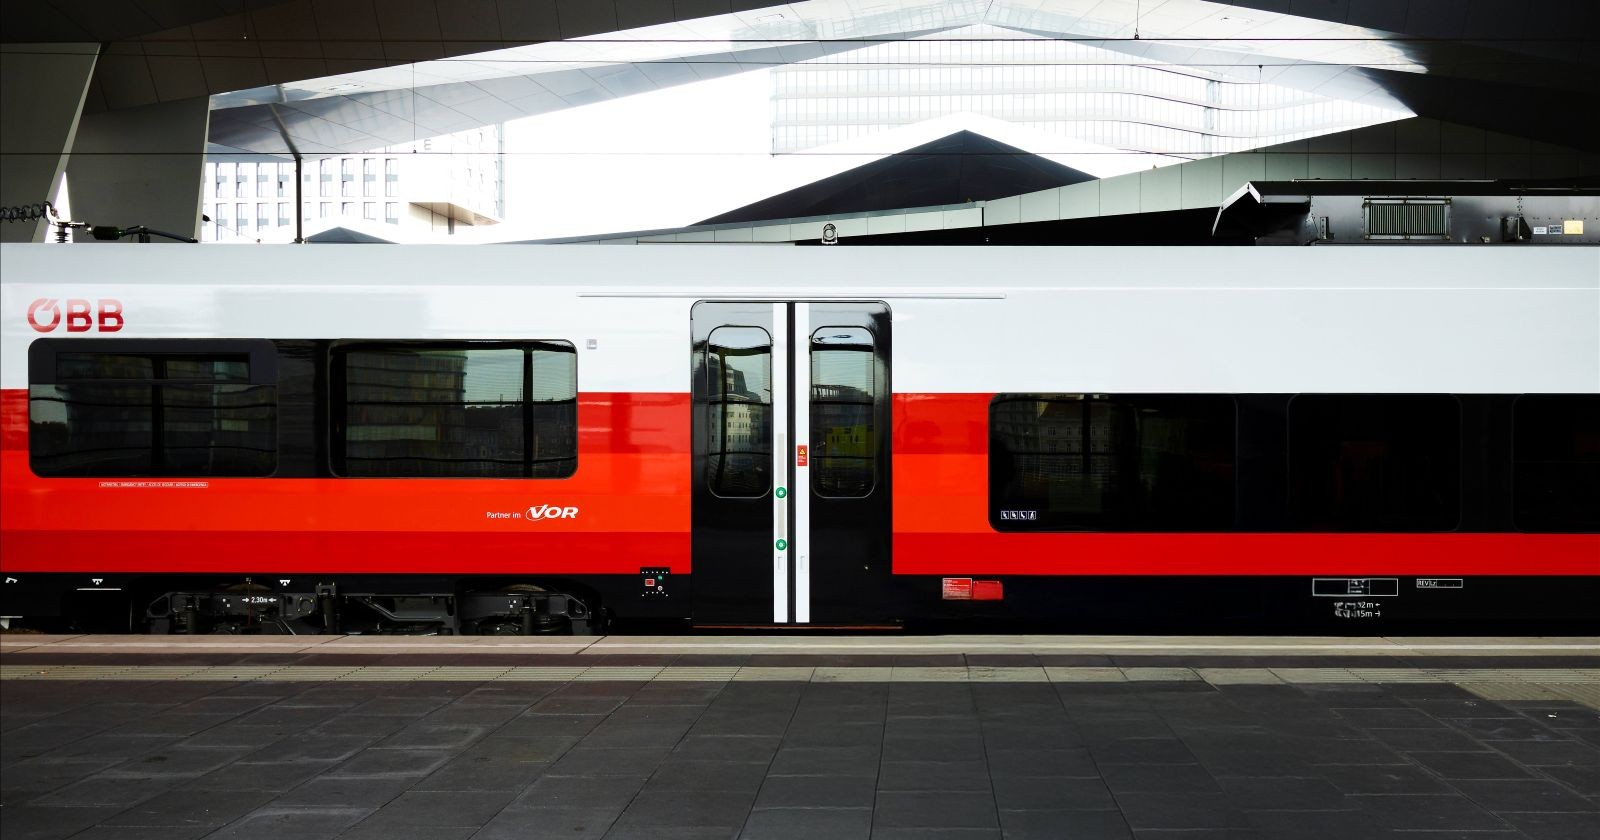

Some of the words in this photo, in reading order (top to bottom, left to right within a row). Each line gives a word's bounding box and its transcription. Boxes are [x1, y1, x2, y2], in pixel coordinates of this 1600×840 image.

[27, 297, 124, 333] ÖBB
[486, 511, 510, 519] Partner
[512, 511, 521, 519] im
[527, 503, 579, 520] VOR
